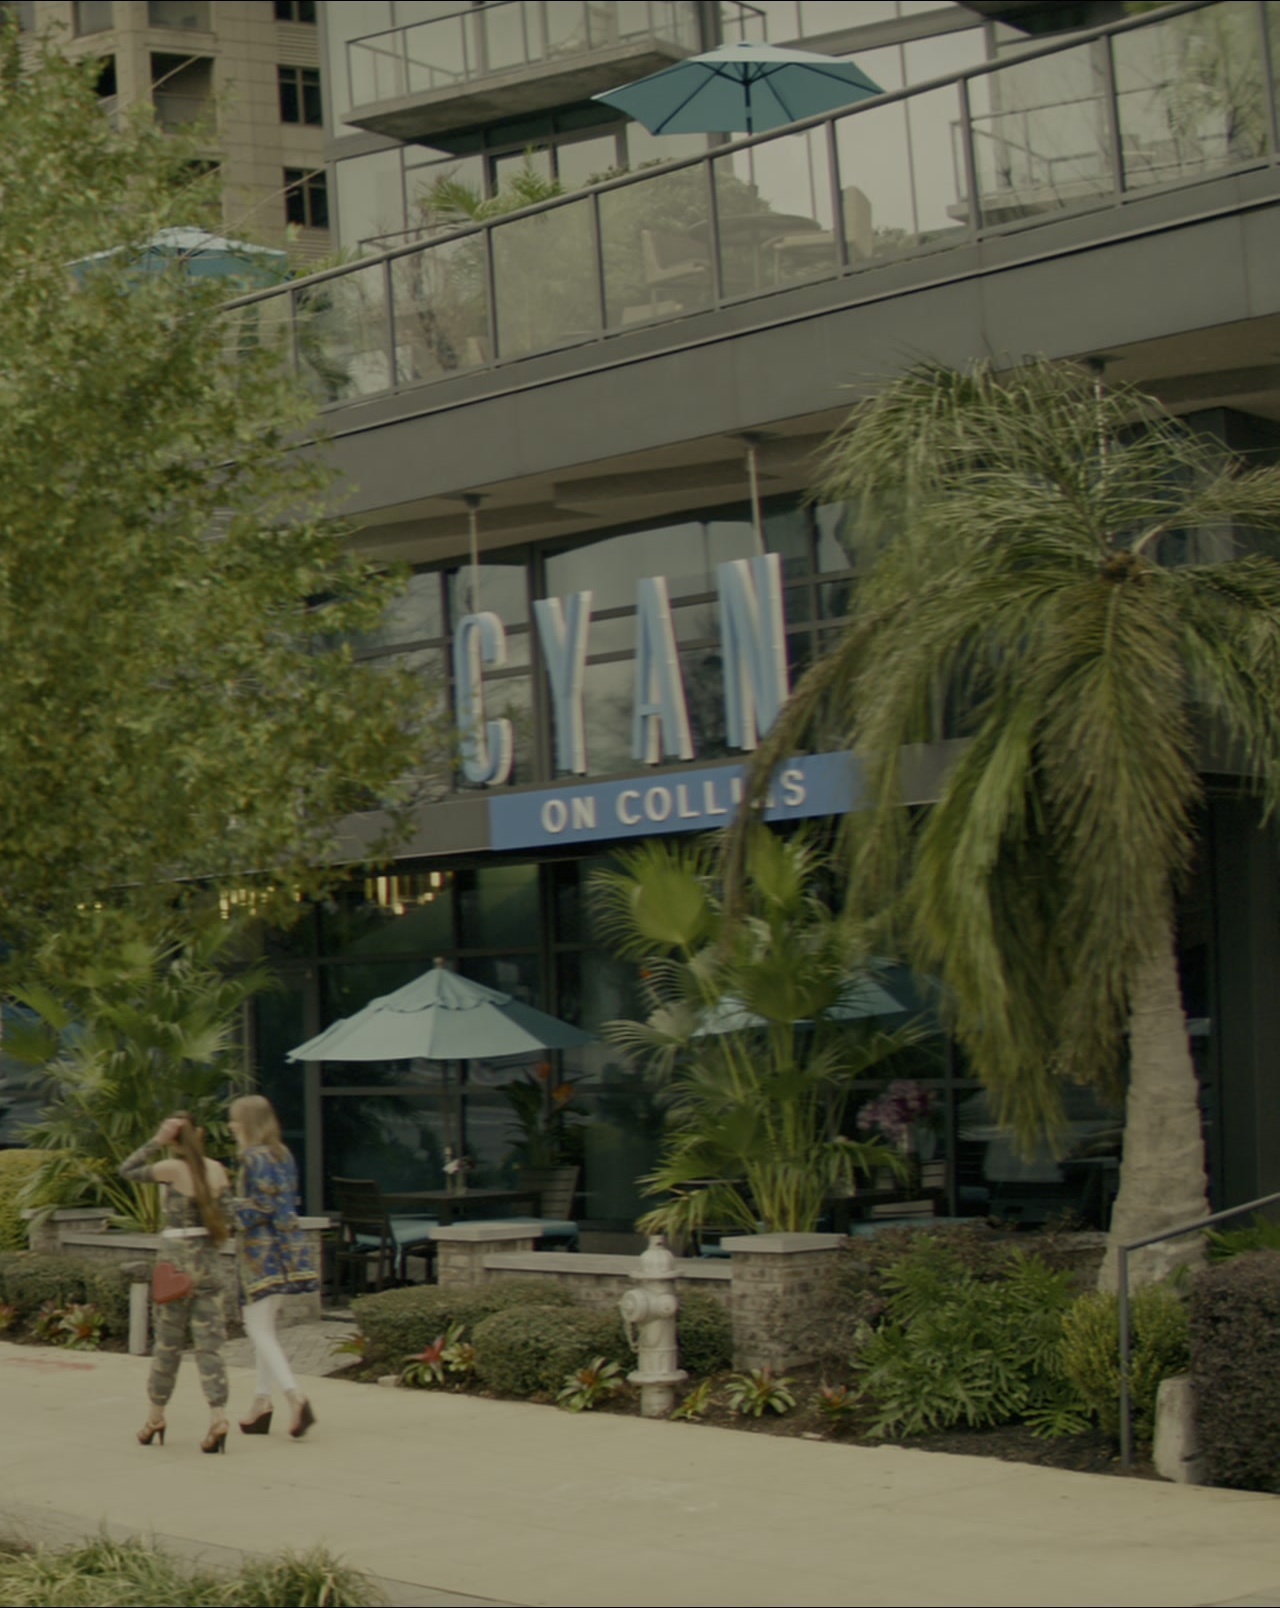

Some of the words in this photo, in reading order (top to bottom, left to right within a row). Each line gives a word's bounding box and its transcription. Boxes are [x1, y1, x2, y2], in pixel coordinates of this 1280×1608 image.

[453, 552, 790, 786] CYAN
[541, 795, 597, 834] ON
[615, 768, 807, 826] COLLIS
